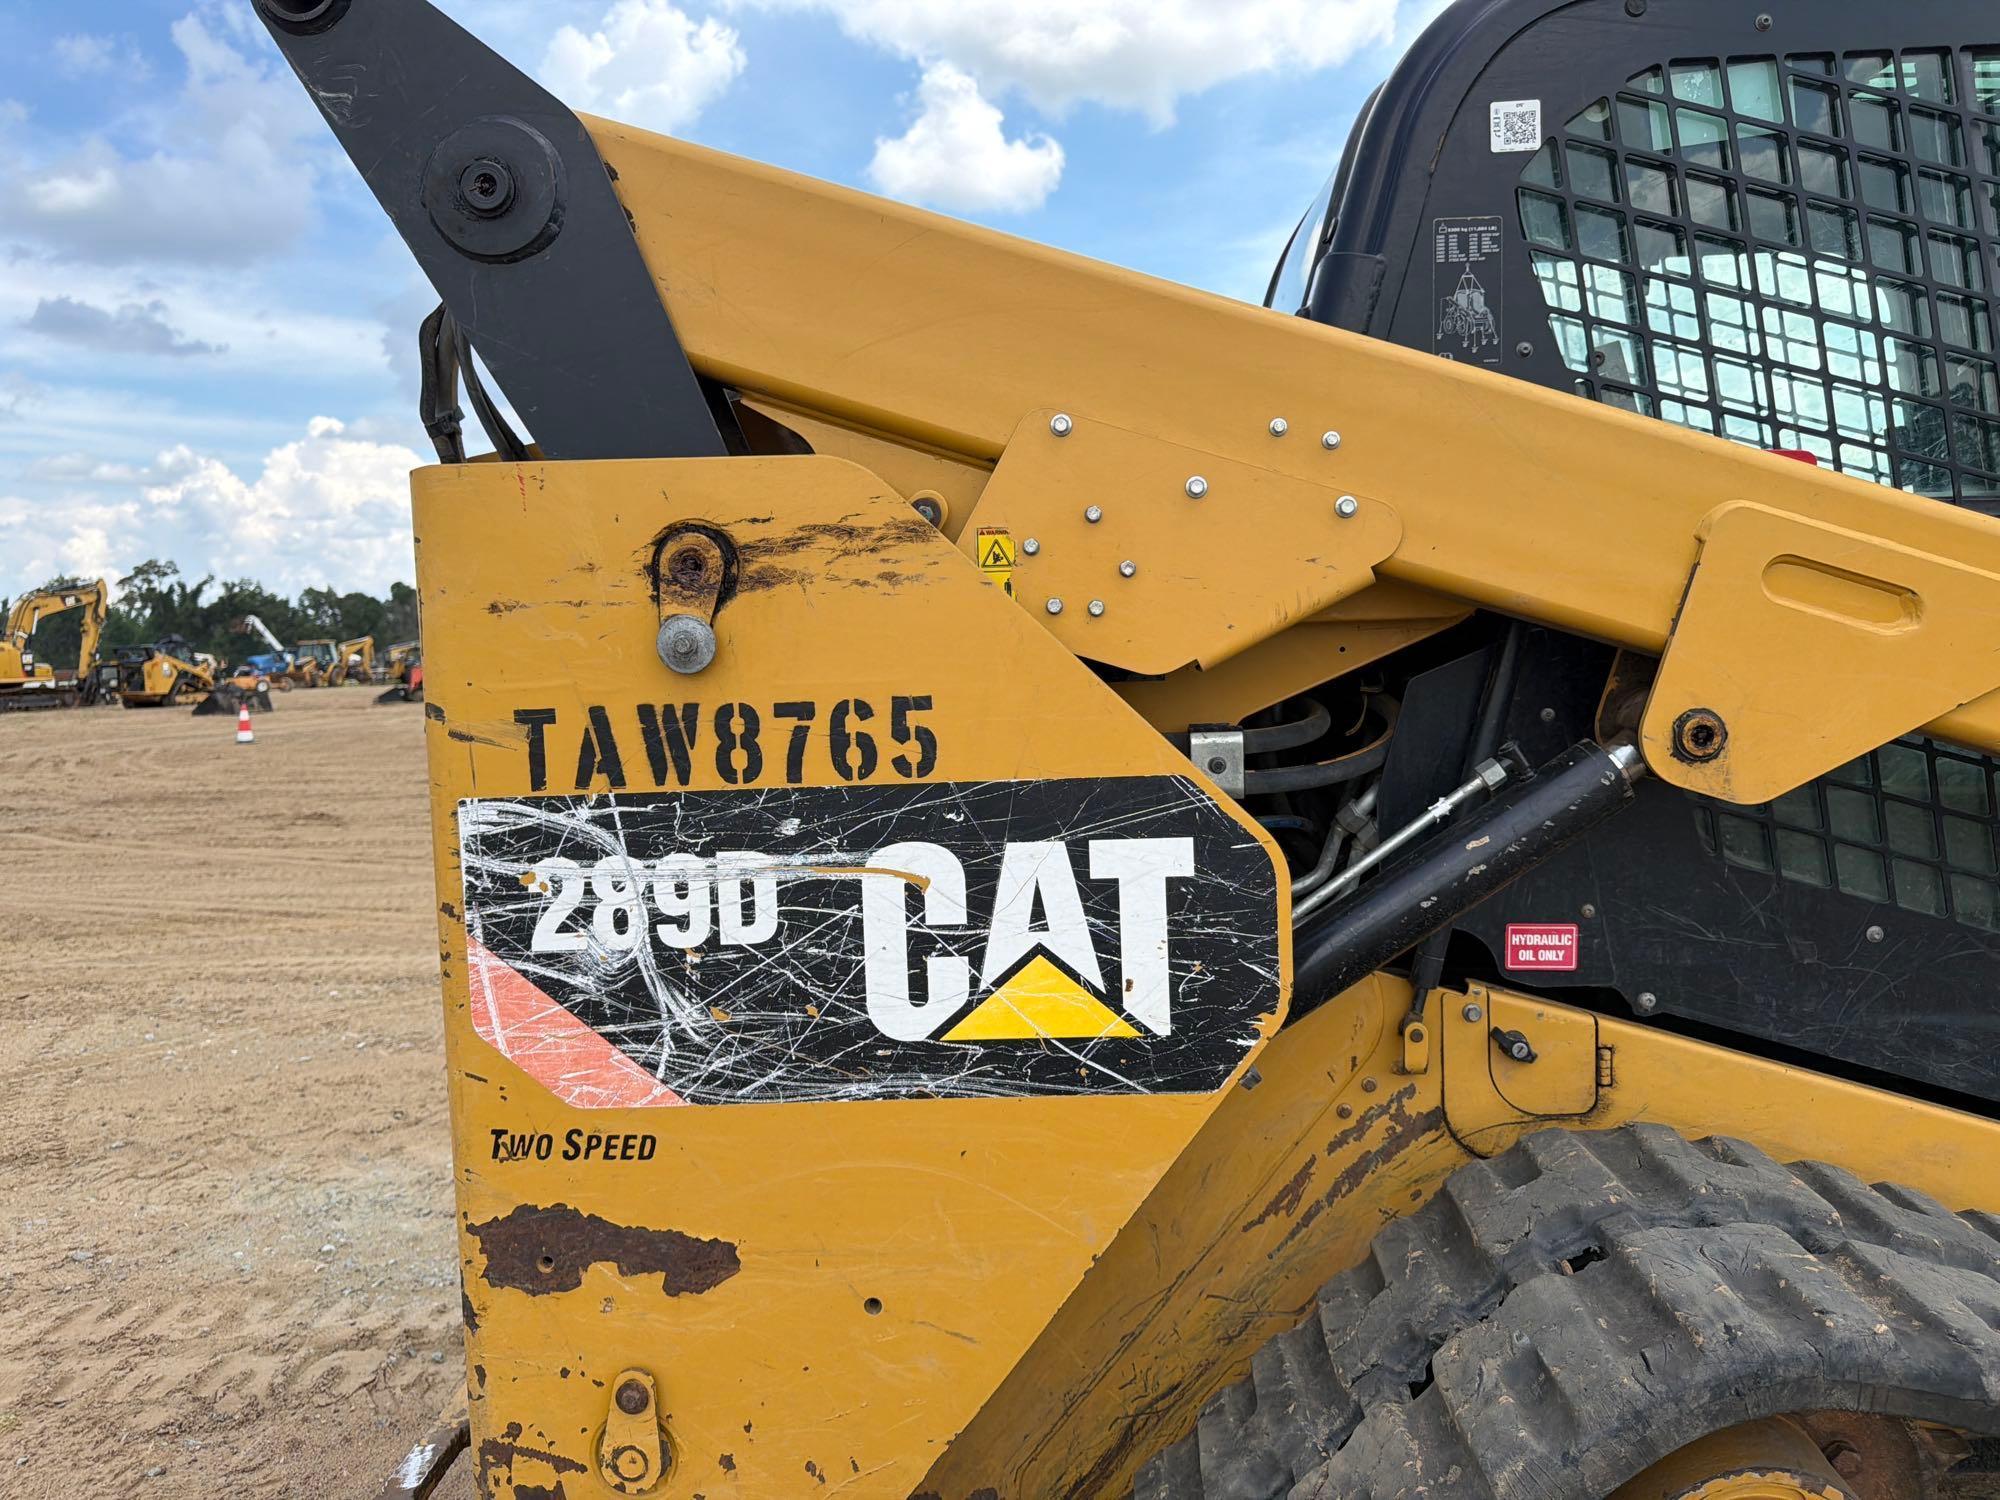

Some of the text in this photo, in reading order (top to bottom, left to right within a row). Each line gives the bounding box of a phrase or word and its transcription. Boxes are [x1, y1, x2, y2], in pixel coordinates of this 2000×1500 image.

[514, 696, 937, 791] TAW8765
[526, 837, 1195, 1042] 289D CAT
[1511, 934, 1572, 945] HYDRAULIC
[1518, 949, 1565, 961] OIL ONLY
